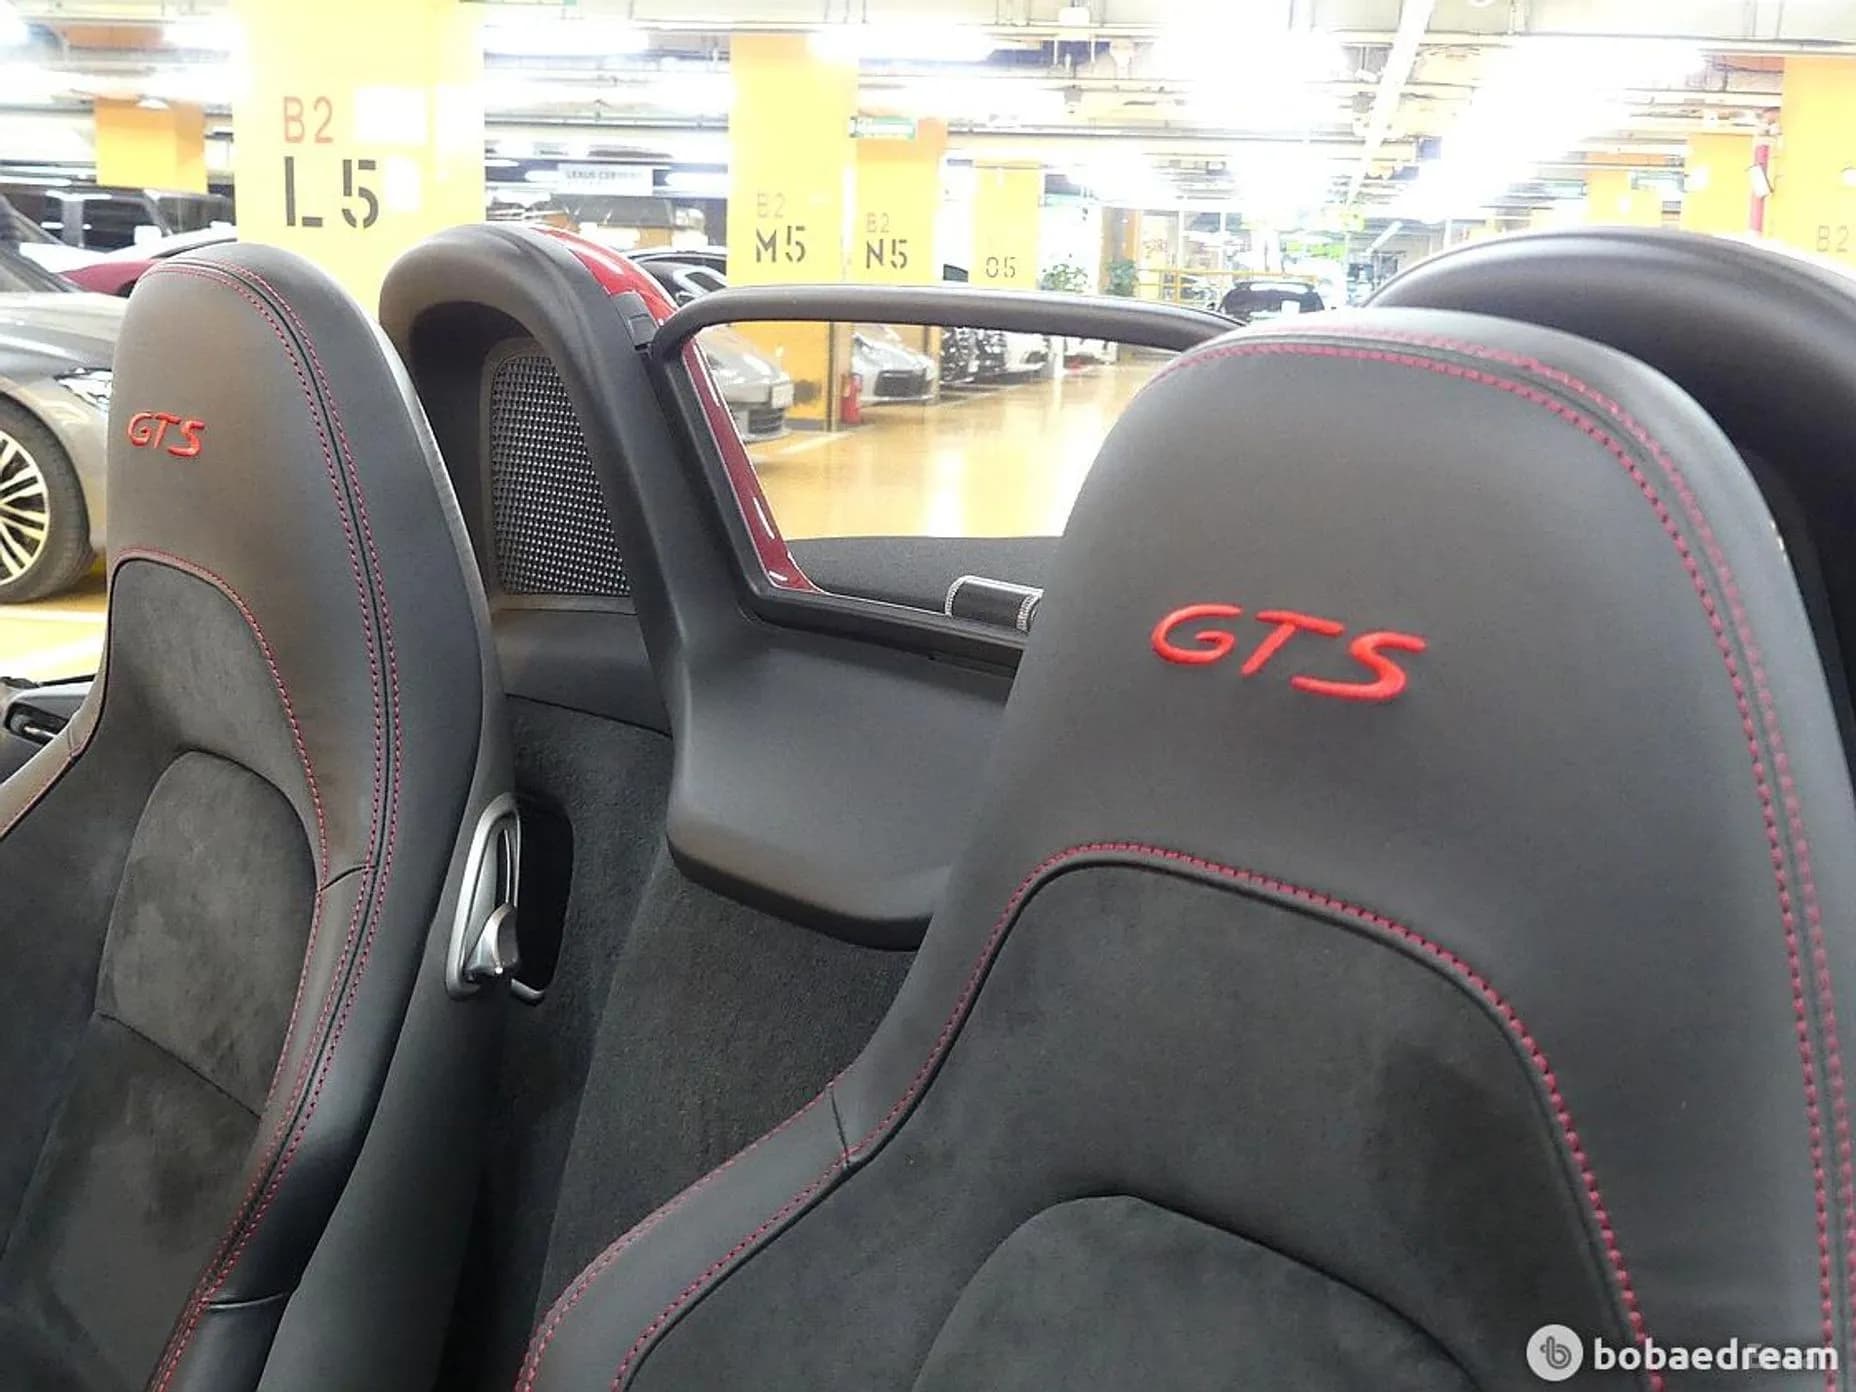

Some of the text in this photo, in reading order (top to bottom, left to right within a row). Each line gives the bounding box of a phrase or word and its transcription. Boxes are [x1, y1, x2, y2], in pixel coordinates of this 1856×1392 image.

[283, 95, 334, 143] B2
[756, 191, 786, 219] B2
[865, 211, 890, 234] B2
[755, 225, 806, 263] M5
[865, 238, 908, 270] N5
[1816, 224, 1849, 253] B2
[127, 411, 206, 458] GTS
[1151, 603, 1428, 700] GTS
